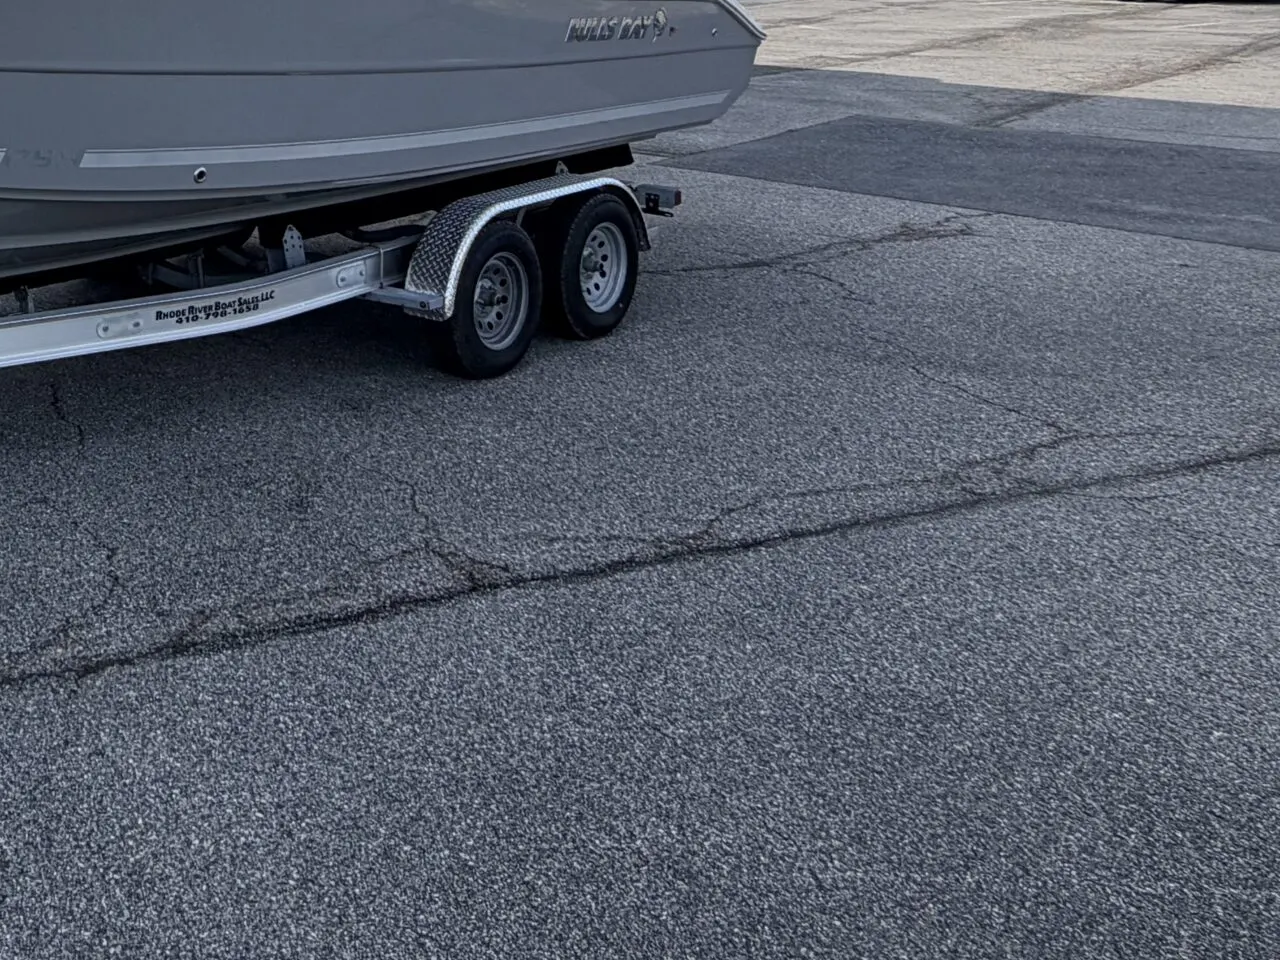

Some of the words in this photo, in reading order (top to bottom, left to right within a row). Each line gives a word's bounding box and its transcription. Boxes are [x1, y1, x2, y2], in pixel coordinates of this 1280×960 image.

[156, 309, 186, 321] RHODE
[187, 304, 213, 316] RIVER
[214, 300, 236, 312] BOAT
